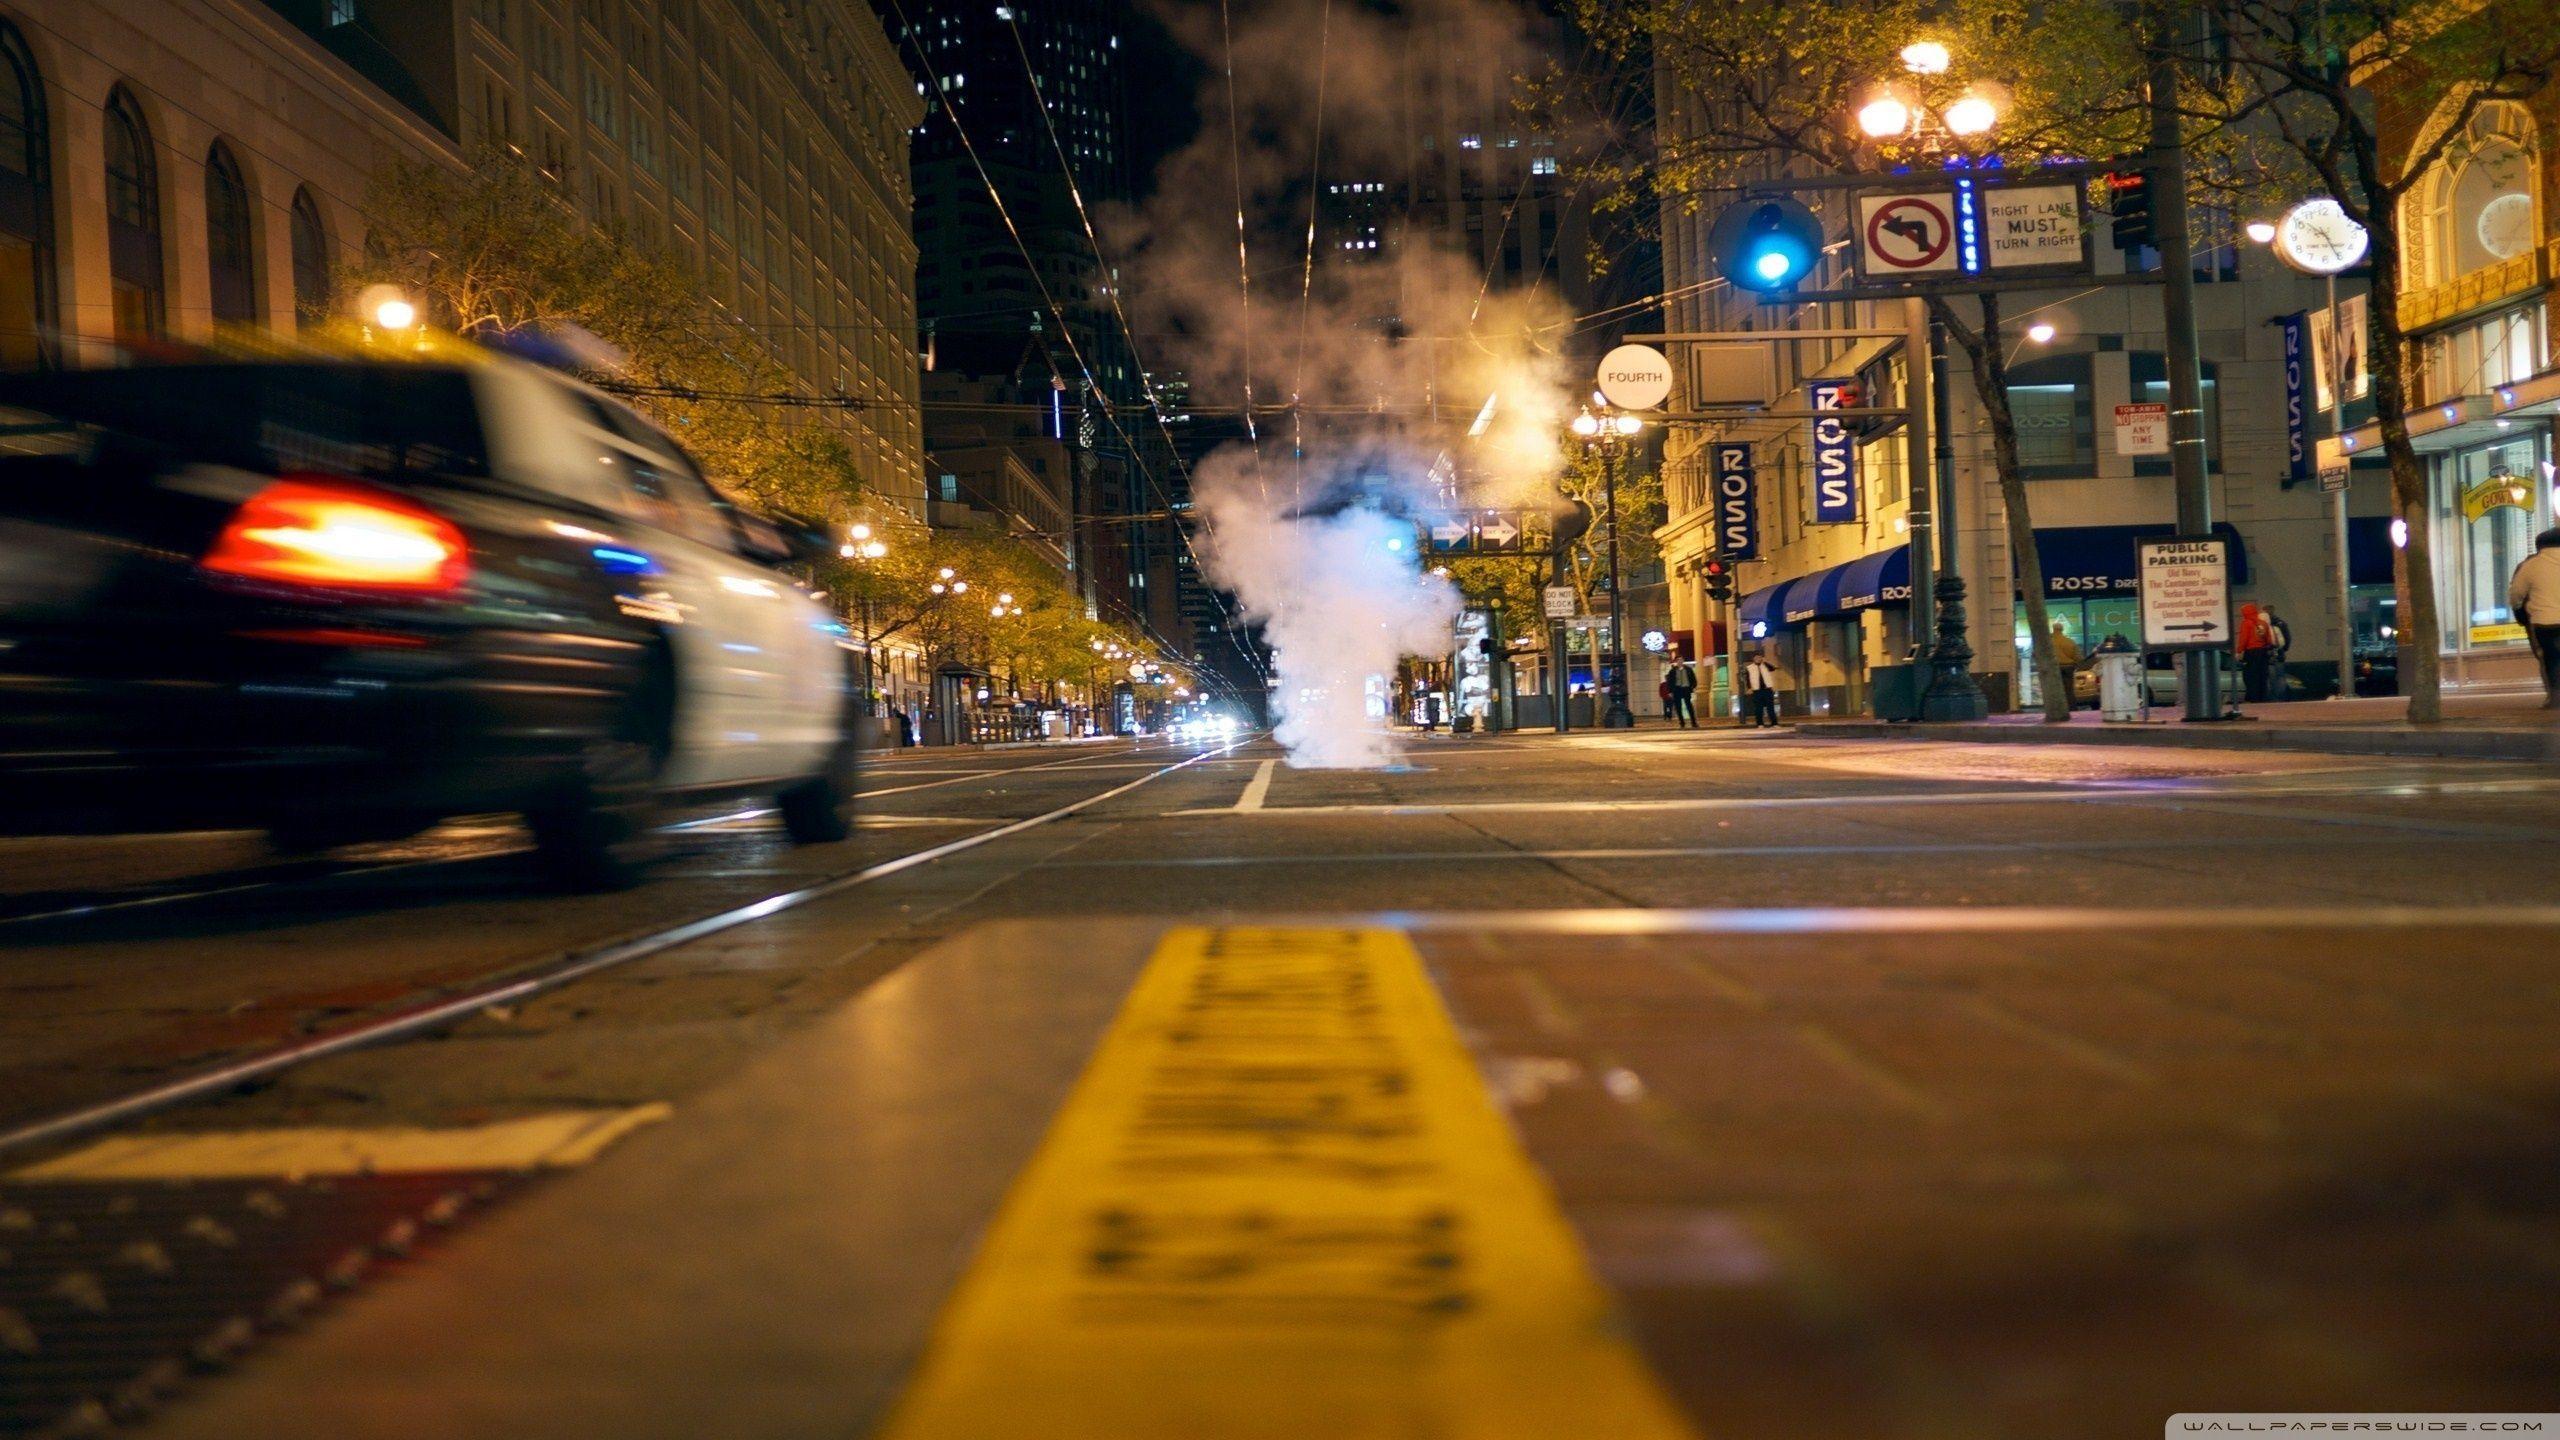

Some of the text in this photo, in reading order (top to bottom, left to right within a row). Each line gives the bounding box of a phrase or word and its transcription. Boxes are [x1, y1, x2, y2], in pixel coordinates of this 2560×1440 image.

[1992, 202, 2073, 217] RIGHT LANE
[2007, 217, 2058, 234] MUST
[1994, 234, 2075, 250] TURN RIGHT
[1608, 372, 1662, 383] FOURTH
[2286, 325, 2303, 462] ROSS
[2132, 425, 2151, 433] ANY
[2131, 435, 2154, 444] TIME
[1816, 387, 1848, 507] ROSS
[1722, 449, 1748, 548] ROSS
[2157, 543, 2209, 554] PUBLIC
[2149, 554, 2218, 565] PARKING
[2051, 576, 2108, 590] ROSS
